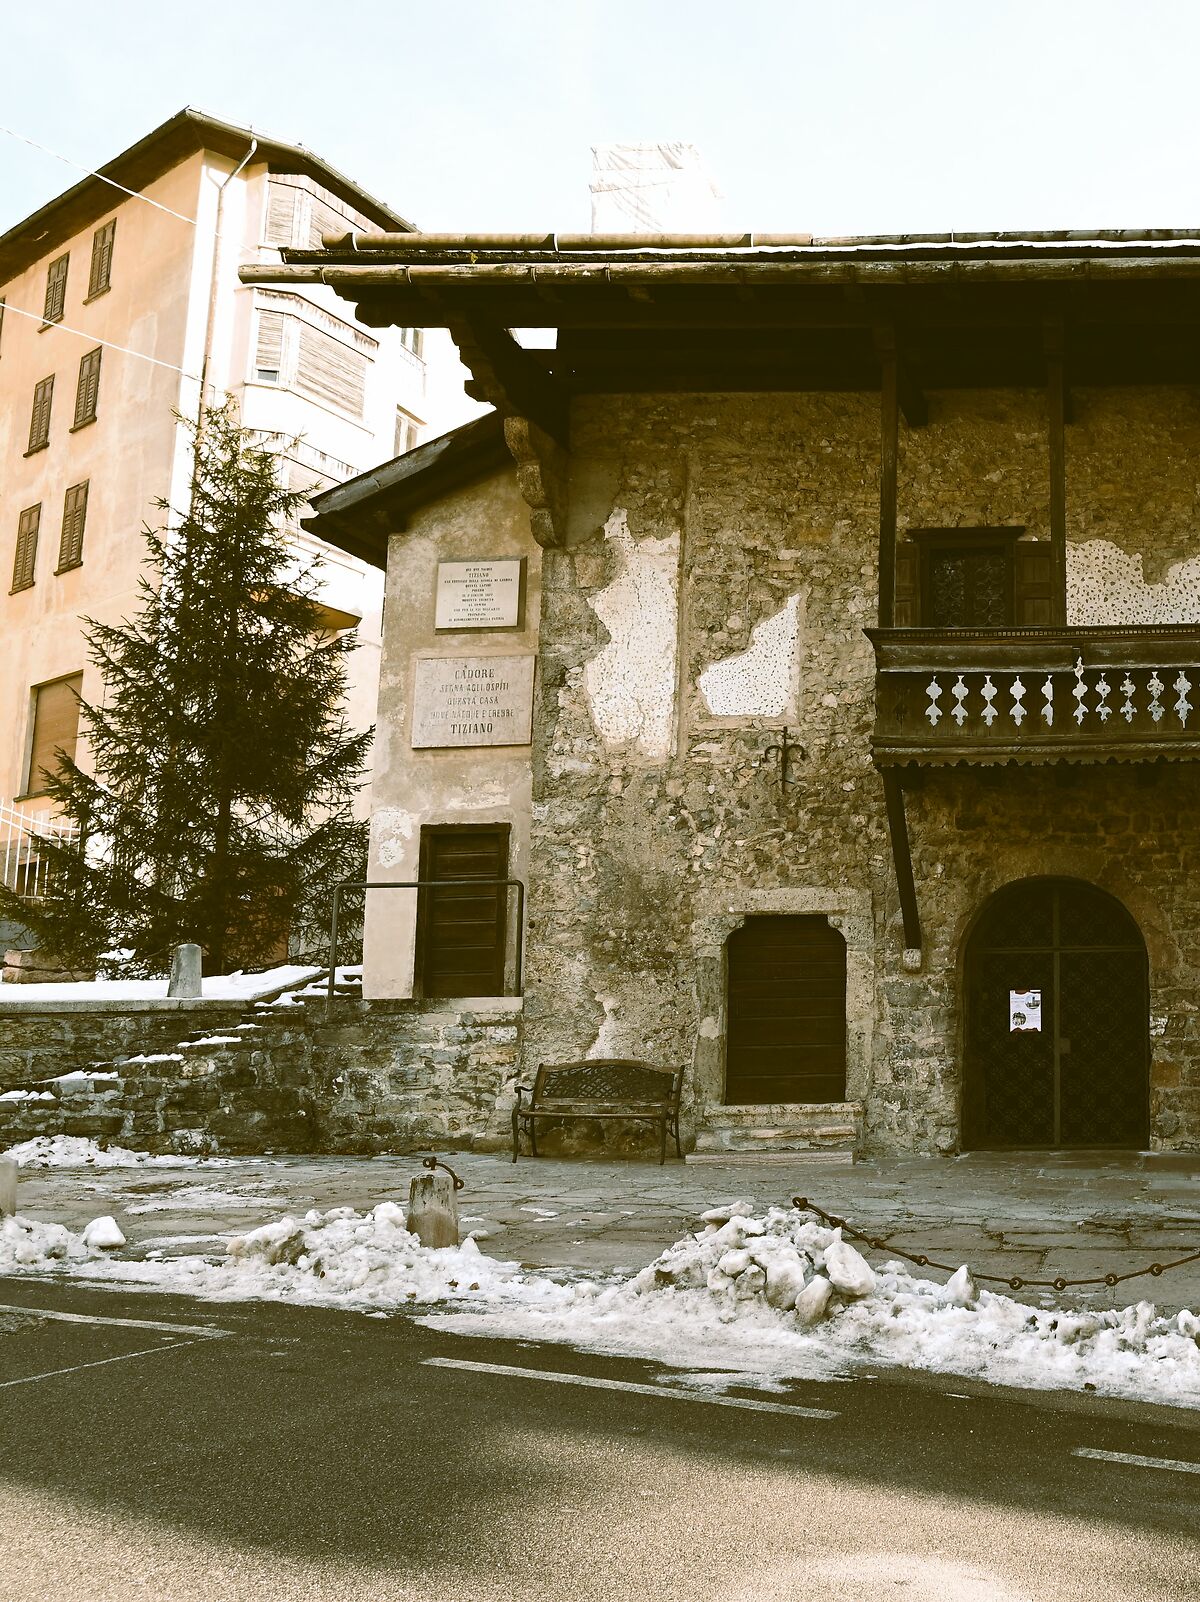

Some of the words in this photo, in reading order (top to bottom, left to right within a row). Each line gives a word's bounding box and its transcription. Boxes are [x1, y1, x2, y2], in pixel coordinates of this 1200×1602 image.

[455, 668, 495, 680] CADORE
[479, 696, 499, 705] CASA
[451, 722, 493, 734] TIZIANO
